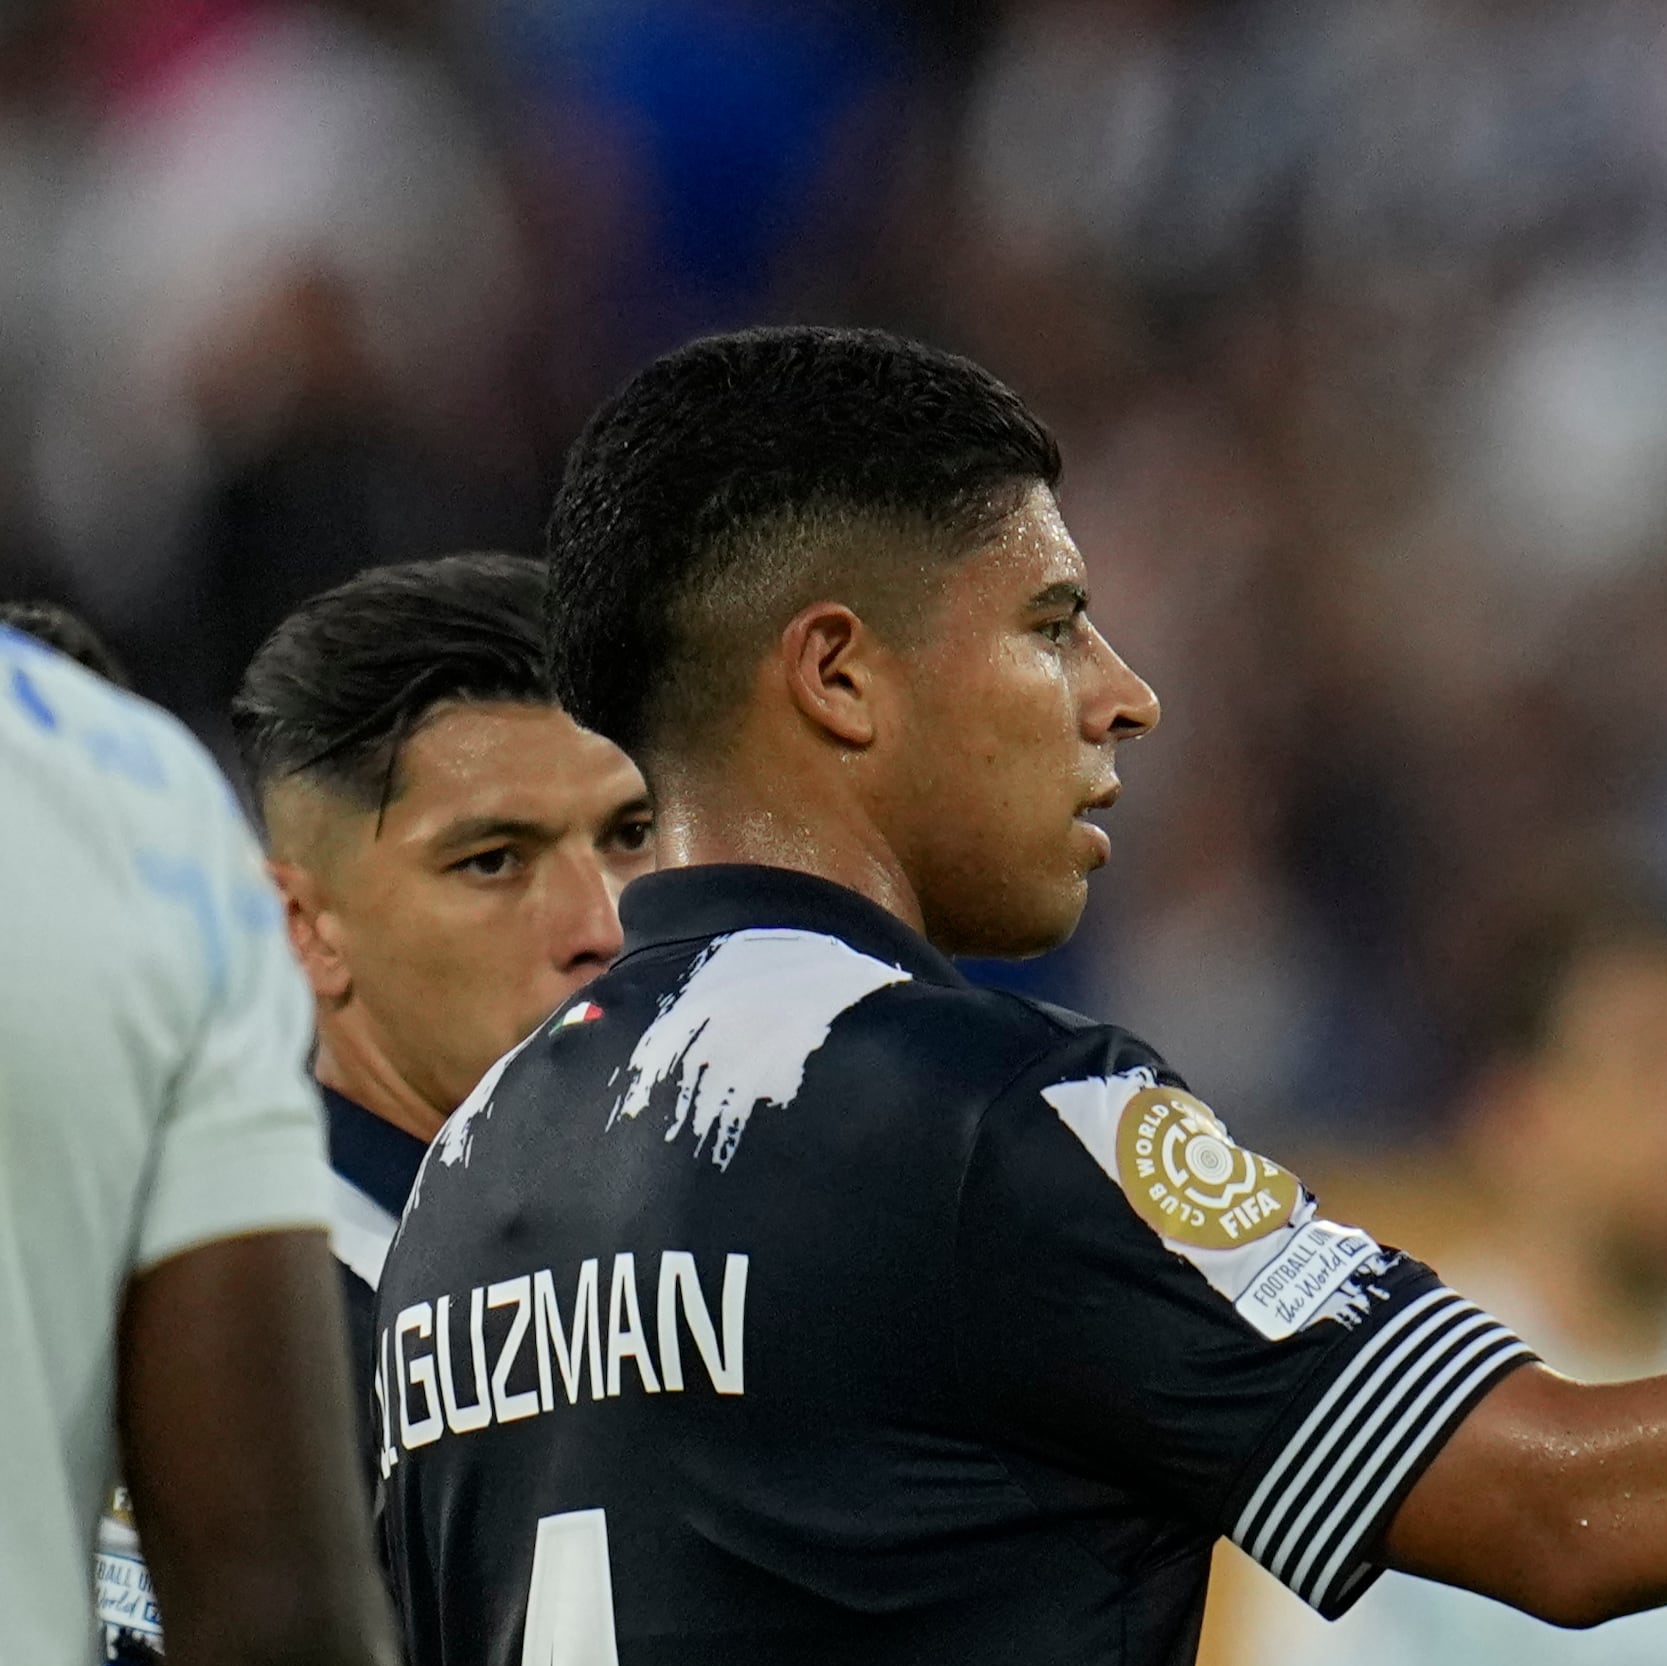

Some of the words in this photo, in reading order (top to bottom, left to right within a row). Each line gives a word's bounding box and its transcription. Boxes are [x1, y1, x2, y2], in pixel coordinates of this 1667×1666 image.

[1136, 1104, 1169, 1178] WORLD
[1149, 1183, 1205, 1227] CLUB
[1219, 1189, 1281, 1239] FIFA
[1253, 1245, 1318, 1308] FOOTBALL
[1295, 1248, 1347, 1298] World
